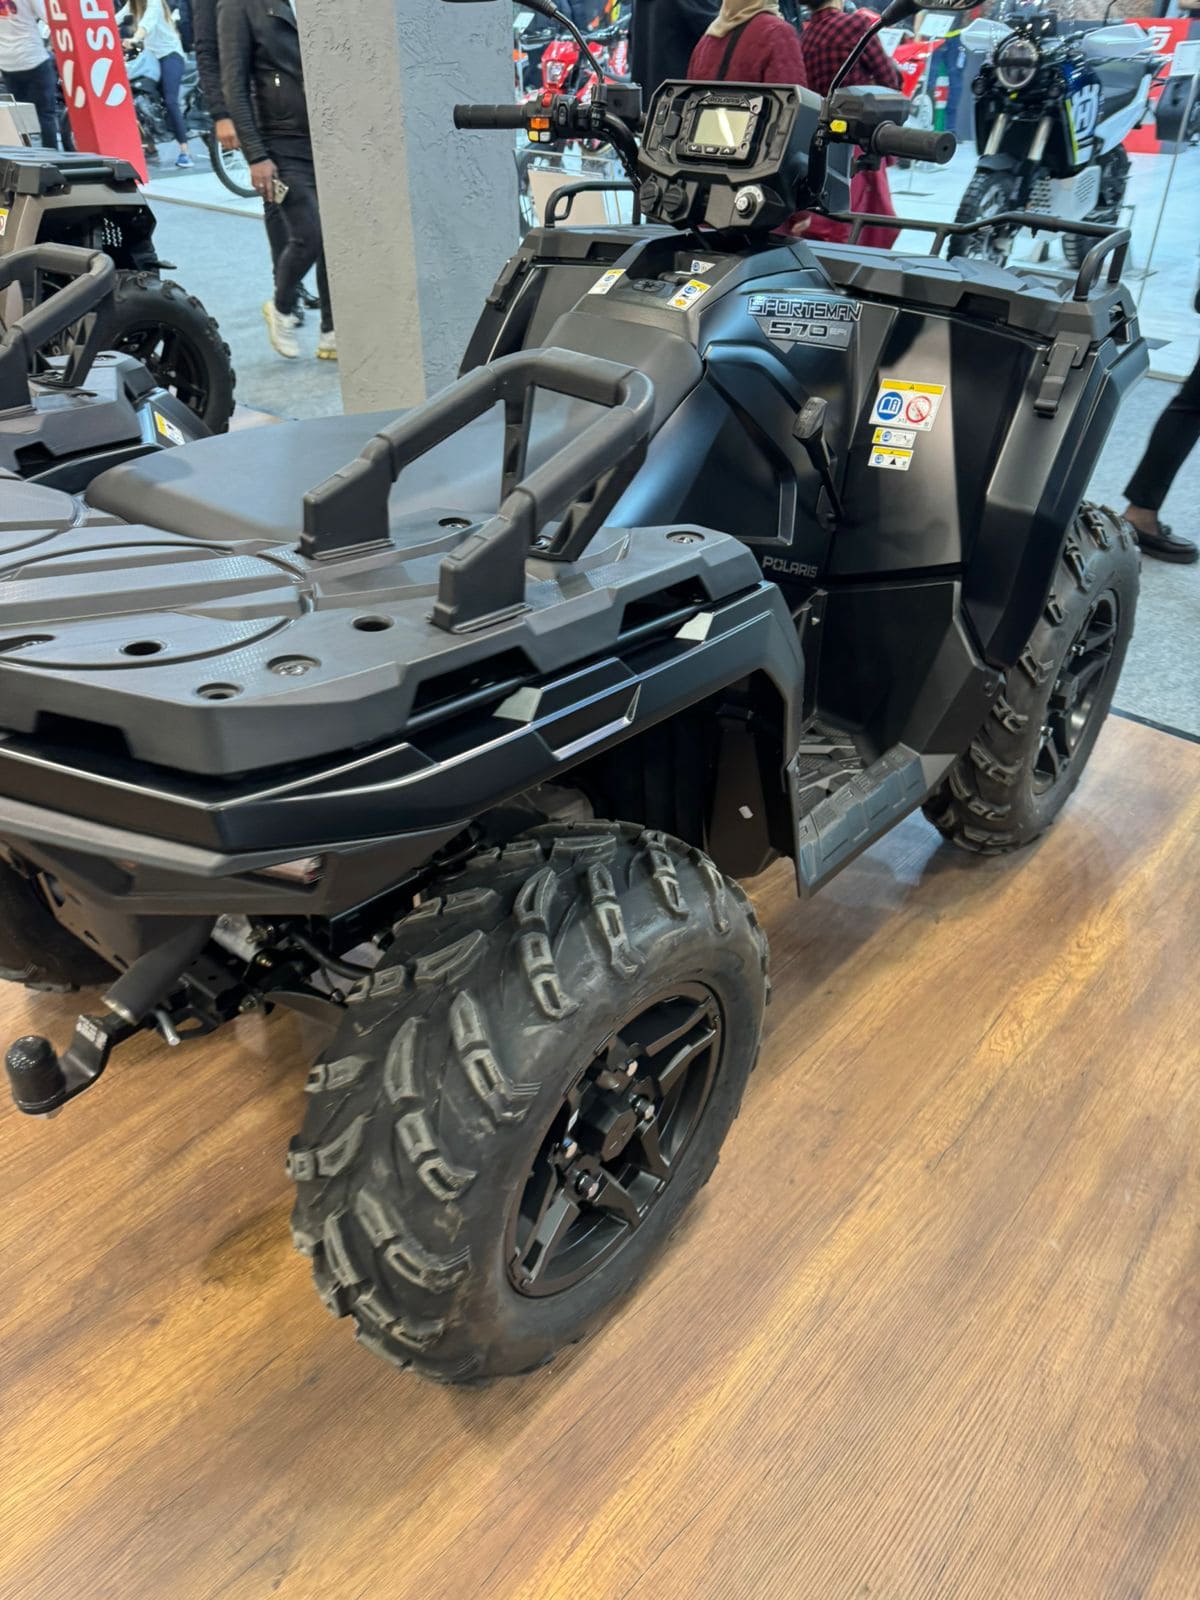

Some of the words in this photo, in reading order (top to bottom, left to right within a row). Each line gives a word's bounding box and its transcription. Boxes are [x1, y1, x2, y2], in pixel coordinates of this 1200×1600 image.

[747, 296, 864, 322] SPORTSMAN
[768, 319, 829, 339] 570
[762, 555, 819, 578] POLARIS
